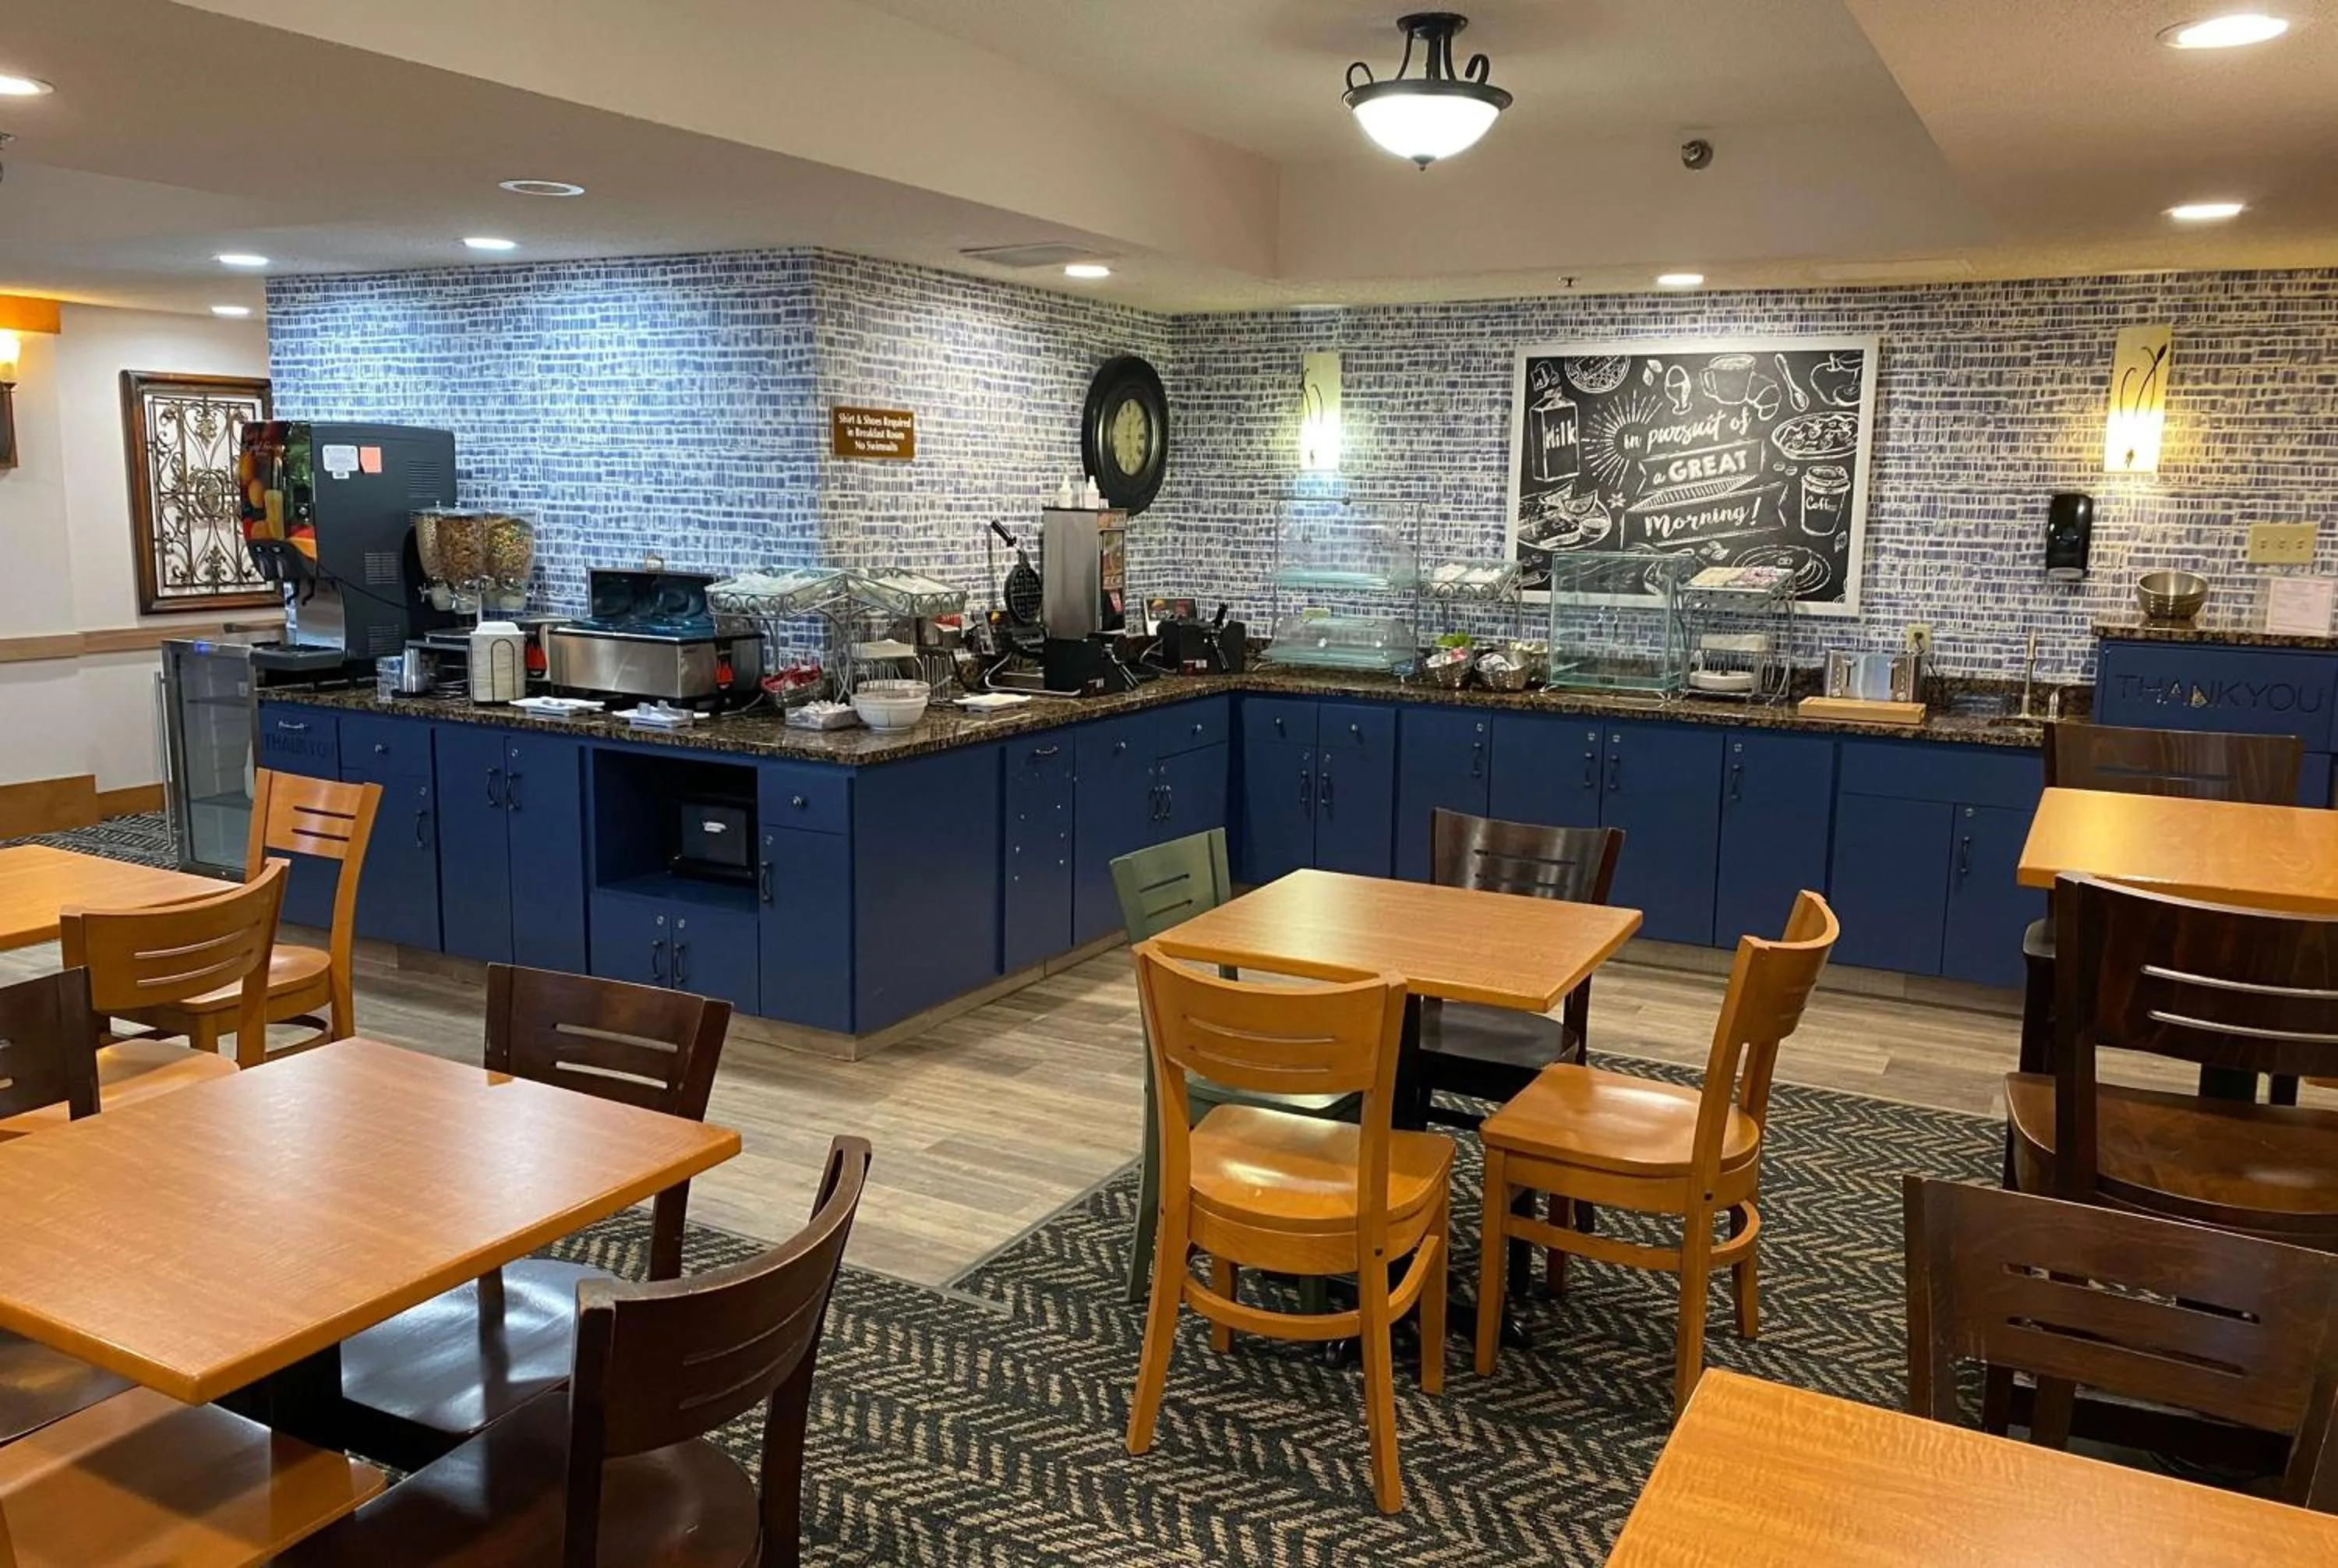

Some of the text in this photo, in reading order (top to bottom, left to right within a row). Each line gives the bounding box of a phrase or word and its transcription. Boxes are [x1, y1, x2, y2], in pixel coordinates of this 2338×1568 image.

[1545, 420, 1577, 450] Milk
[1623, 406, 1752, 454] in pursuit of
[1652, 450, 1747, 485] a GREAT
[1644, 496, 1762, 538] Morning!
[1806, 495, 1837, 511] Coff
